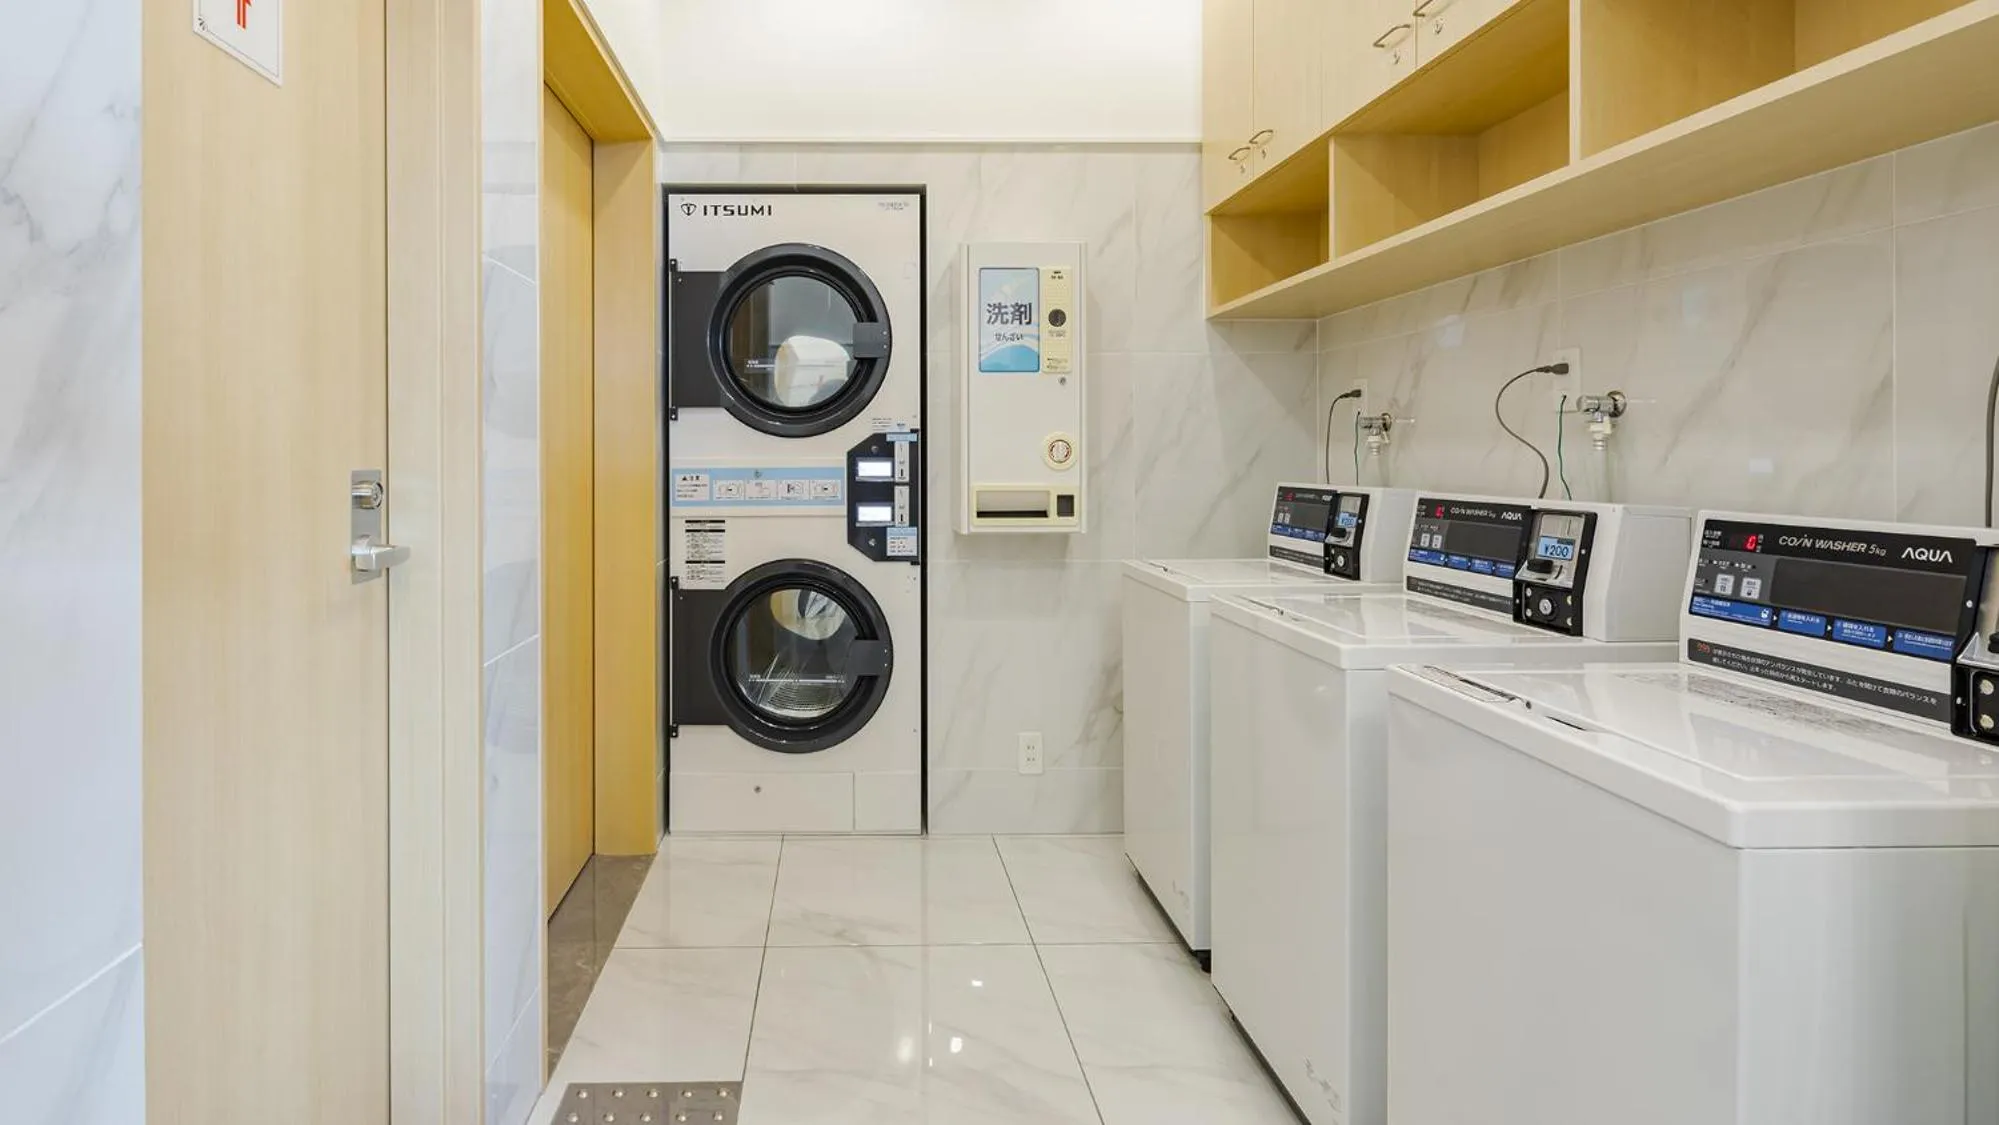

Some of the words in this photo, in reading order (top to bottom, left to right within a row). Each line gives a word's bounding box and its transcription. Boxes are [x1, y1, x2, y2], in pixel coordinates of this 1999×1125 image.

[703, 204, 772, 216] ITSUMI
[986, 302, 1033, 325] 洗剤
[994, 332, 1024, 342] せんざい
[1501, 511, 1522, 521] AQUA
[1544, 543, 1570, 557] ¥200
[1815, 539, 1867, 553] WASHER
[1869, 543, 1887, 557] 5kg
[1902, 547, 1953, 563] AQUA
